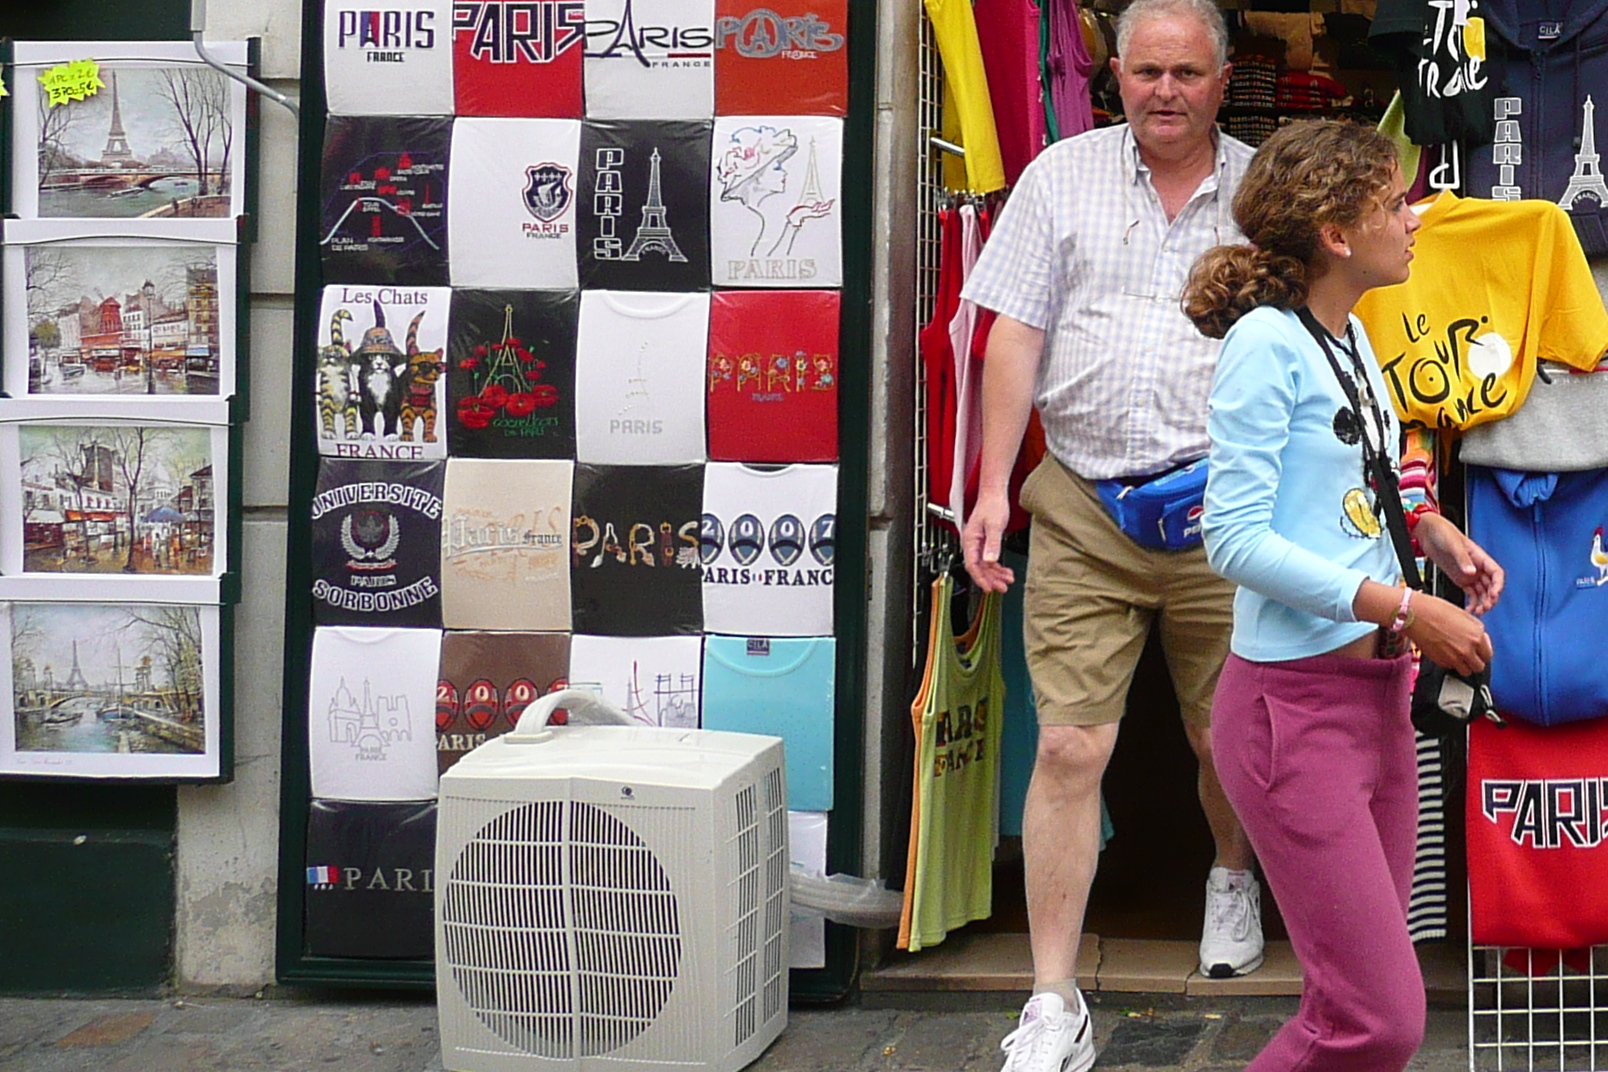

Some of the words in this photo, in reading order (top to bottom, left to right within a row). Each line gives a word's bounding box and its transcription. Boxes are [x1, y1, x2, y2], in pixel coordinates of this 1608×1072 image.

[338, 9, 435, 50] PARIS
[454, 0, 586, 66] PARIS
[715, 7, 844, 60] PARIS
[366, 50, 406, 64] FRANCE
[650, 59, 712, 69] FRANCE
[1491, 96, 1522, 202] PARIS
[593, 147, 625, 261] PARIS
[521, 222, 569, 235] PARIS
[525, 232, 563, 240] FRANCE
[727, 258, 819, 281] PARIS
[341, 287, 373, 305] Les
[375, 287, 429, 306] Chats
[609, 419, 664, 435] PARIS
[335, 443, 425, 460] FRANCE
[573, 521, 702, 569] PARIS
[311, 575, 439, 612] SORBONNE
